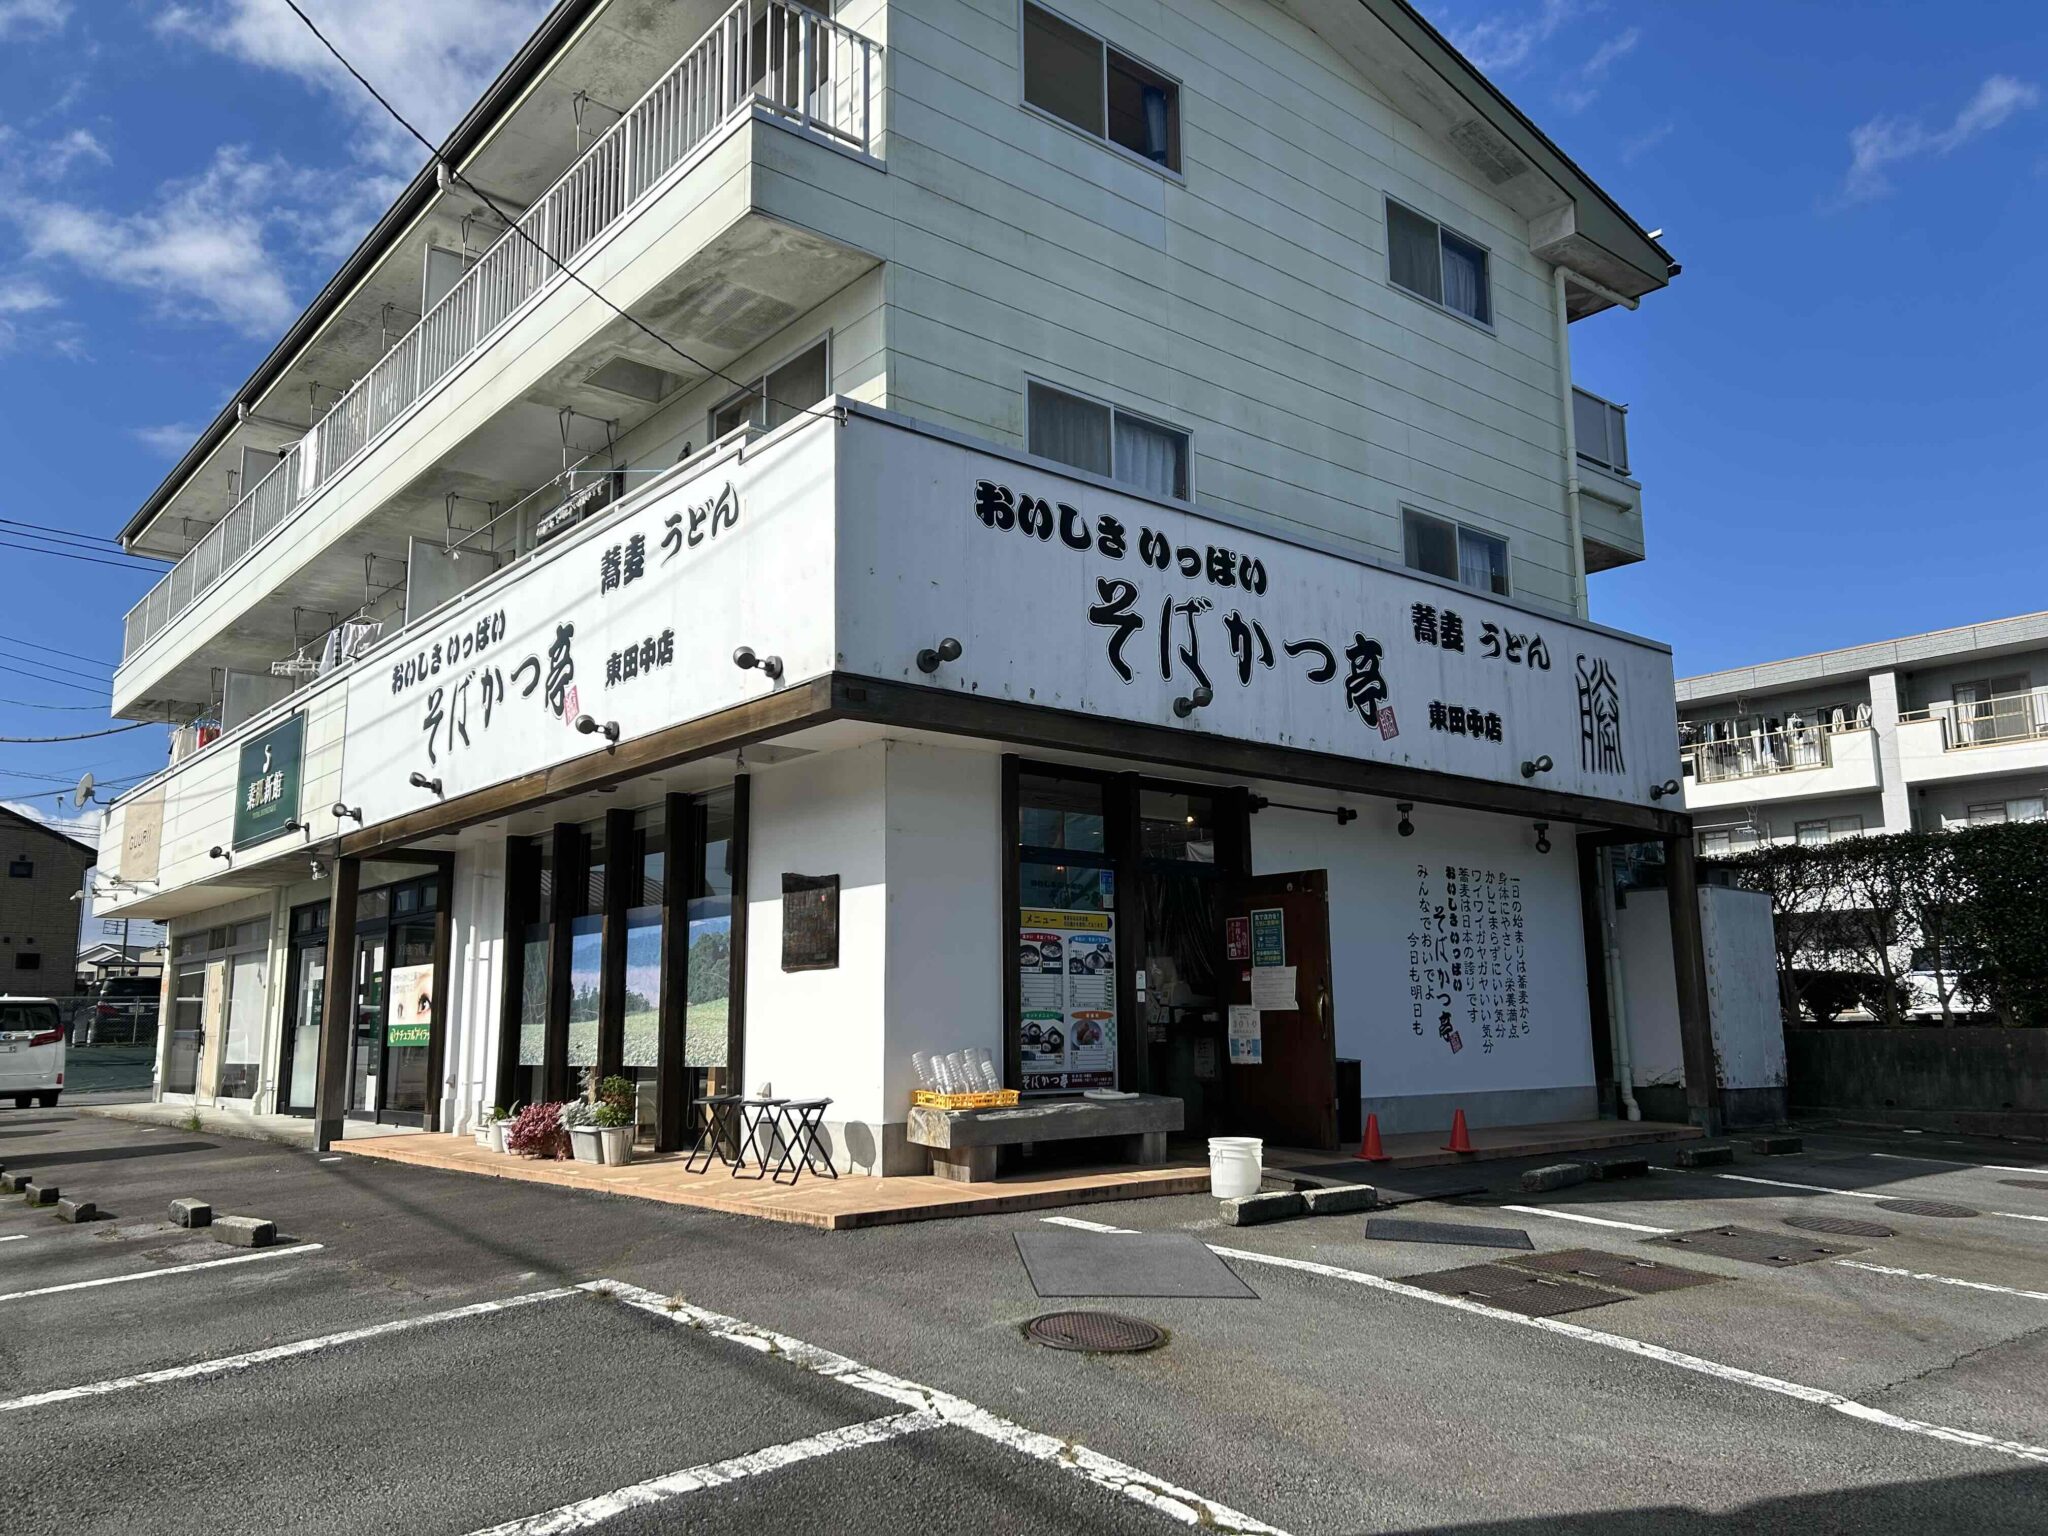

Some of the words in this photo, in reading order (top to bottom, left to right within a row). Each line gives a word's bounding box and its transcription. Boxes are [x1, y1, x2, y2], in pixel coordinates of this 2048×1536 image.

[601, 533, 645, 597] 蕎麦
[661, 481, 739, 567] うどん
[975, 480, 1267, 596] おいしさいっぱい
[392, 609, 506, 694] おいしさいっぱい
[423, 621, 574, 767] そばかつ亭
[605, 629, 674, 690] 東田中店
[1088, 577, 1389, 729] そばかつ亭
[1411, 602, 1465, 654] 蕎麦
[1480, 619, 1551, 671] うどん
[1428, 701, 1502, 744] 東田中店
[1025, 914, 1057, 924] メニュー
[1417, 865, 1435, 1000] みんなでおいでよ
[1433, 905, 1453, 1042] そばかつ亭
[1459, 868, 1479, 1023] 蕎麦は日本の誇りです
[1471, 870, 1494, 1054] ワイワイガヤガヤいい気分
[1485, 870, 1507, 1038] かしこまらずにいい気分
[1499, 872, 1519, 1039] 身体にやさしく栄養満点
[1510, 877, 1530, 1035] 一日の始まりは蕎麦から
[1407, 932, 1423, 1036] 今日も明日も
[1022, 1073, 1068, 1089] そばかつ亭
